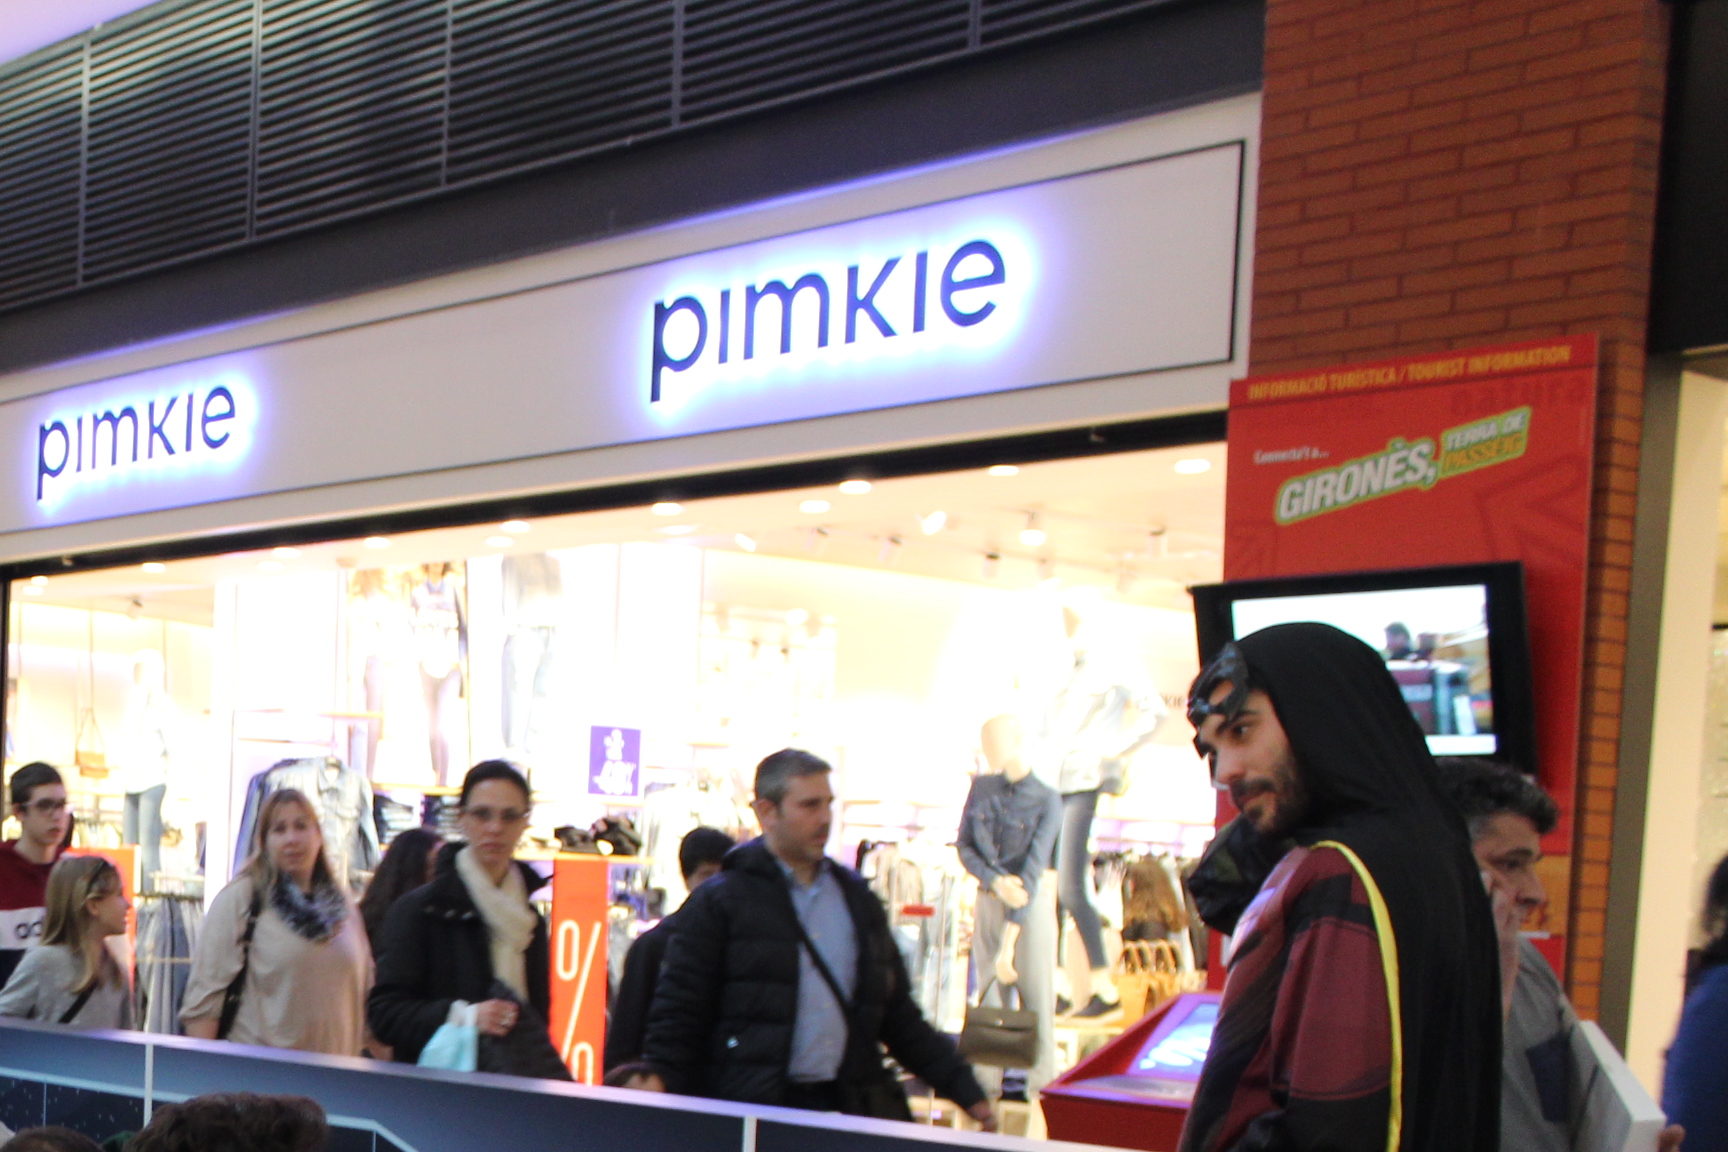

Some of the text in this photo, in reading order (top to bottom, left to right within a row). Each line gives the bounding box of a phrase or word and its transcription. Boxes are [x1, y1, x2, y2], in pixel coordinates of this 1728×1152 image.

[650, 240, 1006, 403] pimkie
[1468, 345, 1571, 374] INFORMATION
[37, 385, 236, 501] pimkie
[1446, 421, 1498, 451] TERRA
